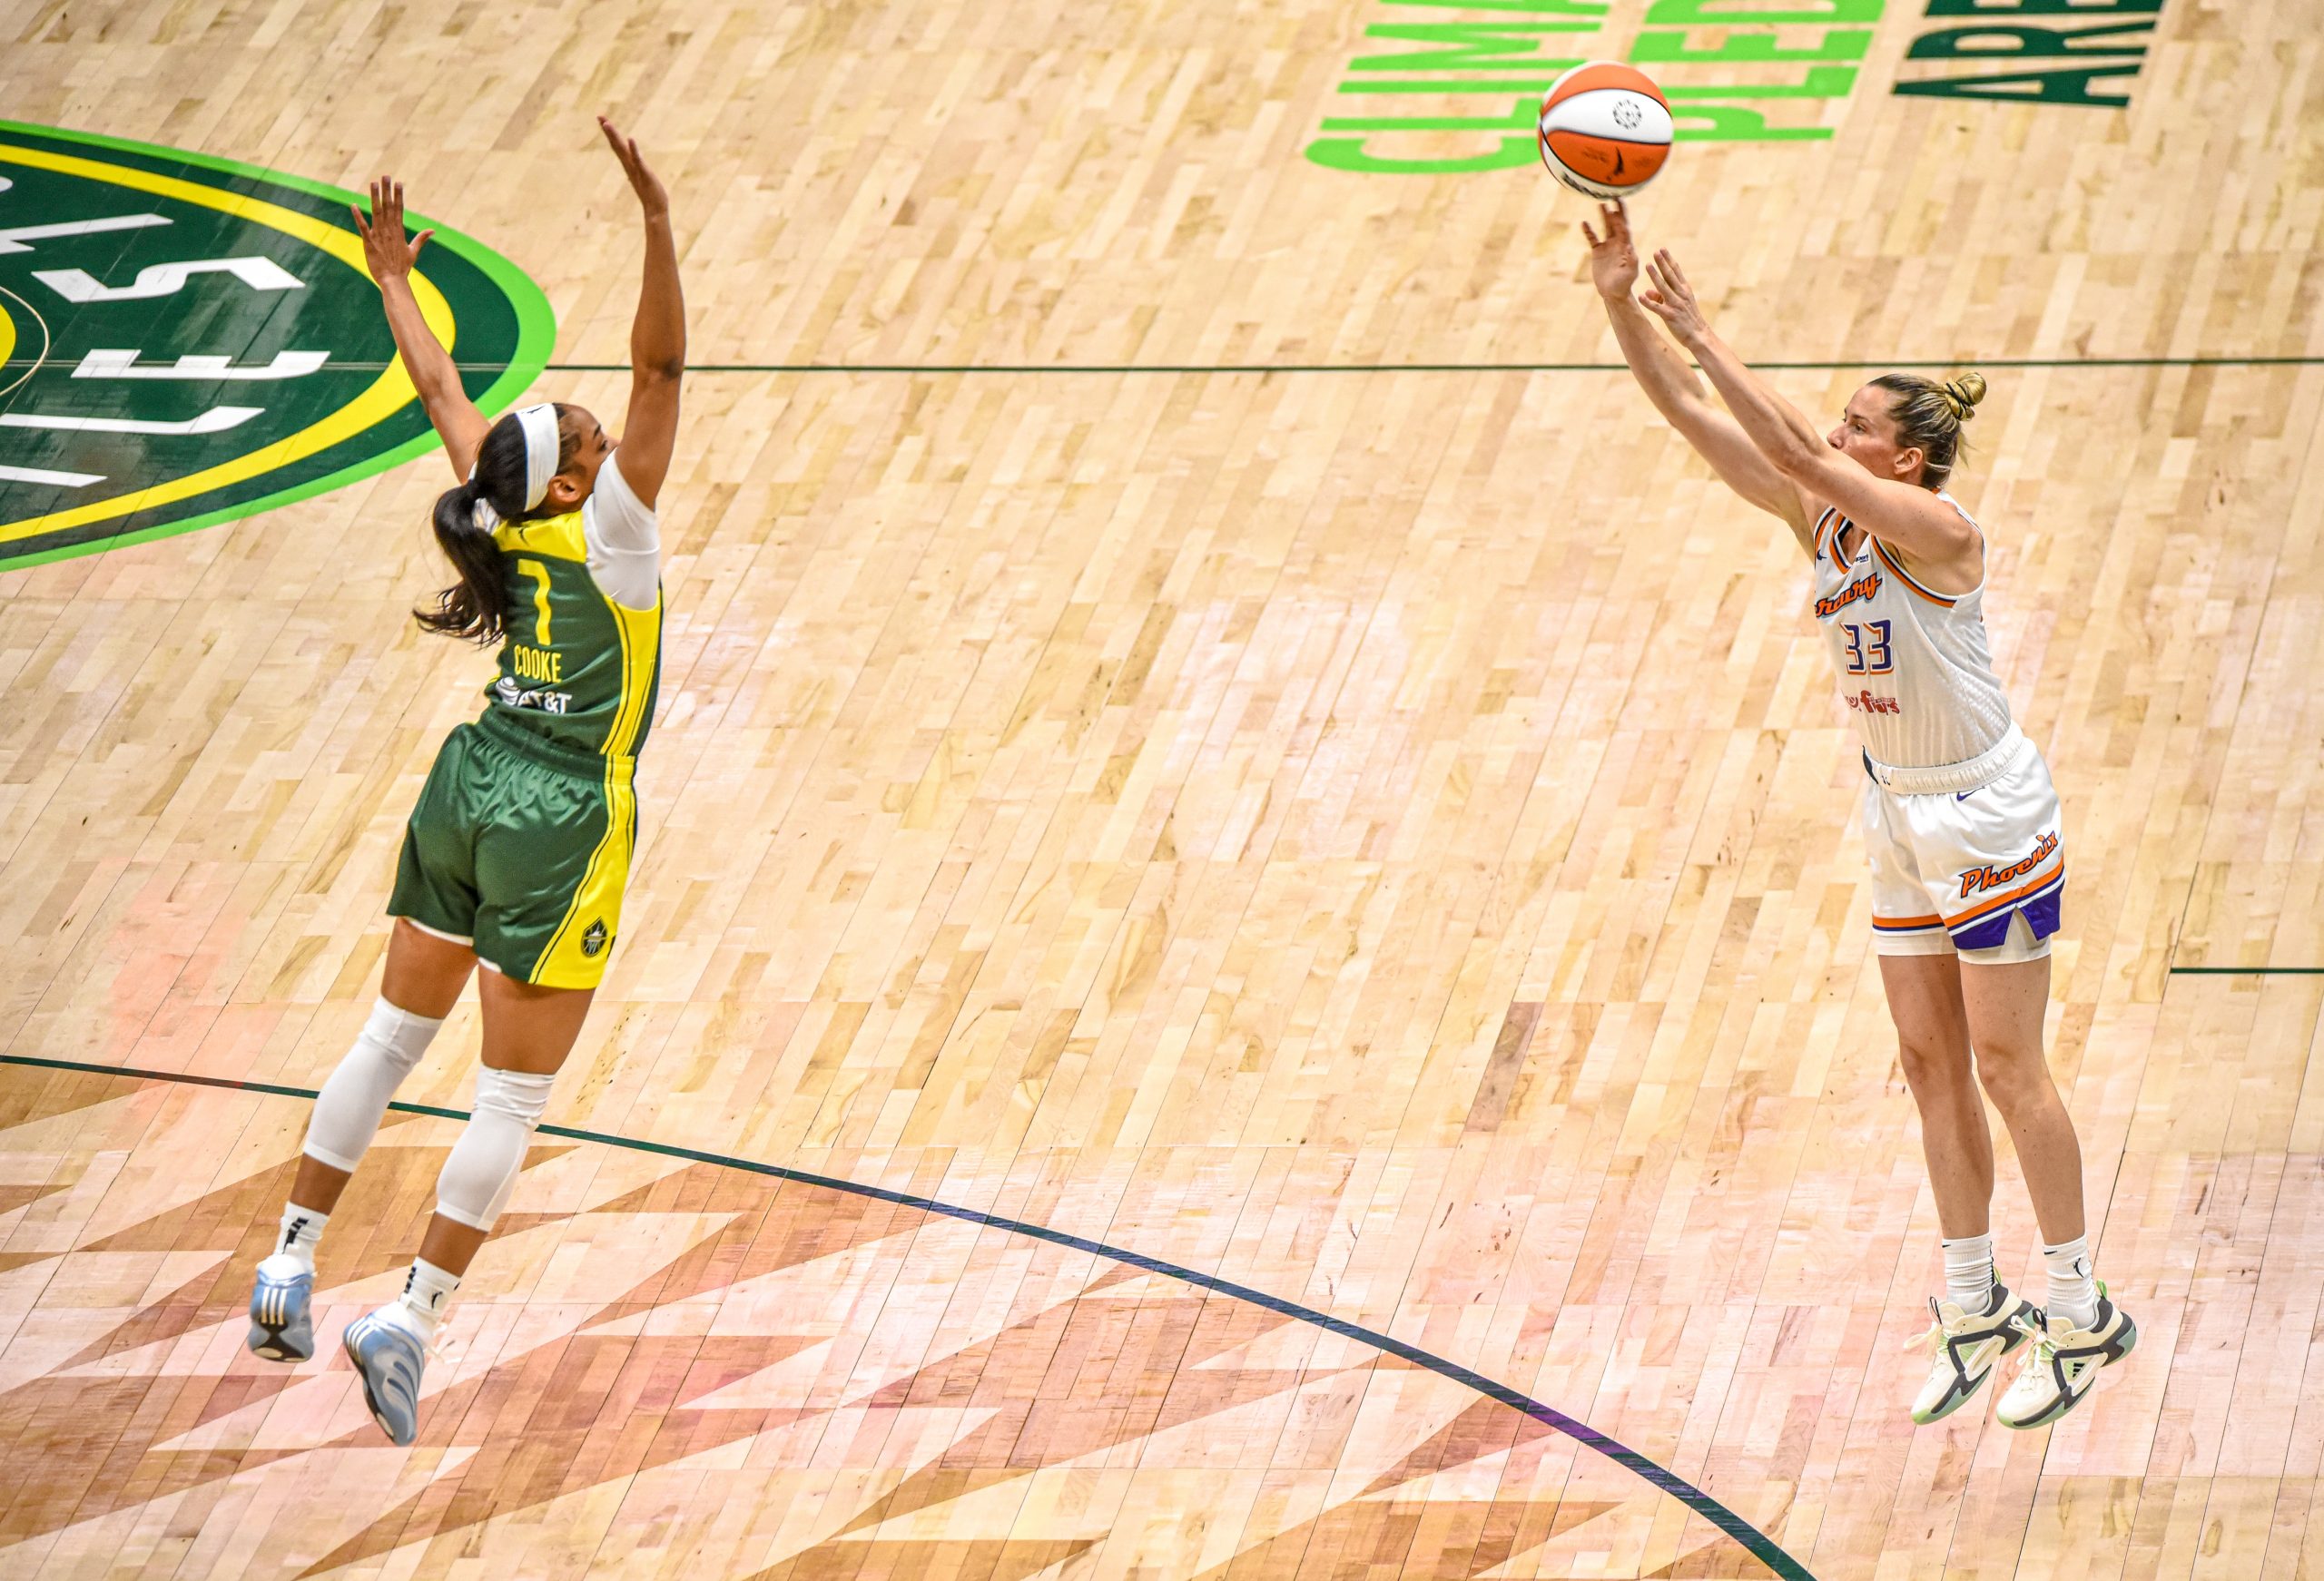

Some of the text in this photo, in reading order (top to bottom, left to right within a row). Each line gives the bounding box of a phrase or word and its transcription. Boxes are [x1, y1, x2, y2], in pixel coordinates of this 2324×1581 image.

[1815, 572, 1883, 618] rcury
[514, 644, 562, 682] COOKE
[1840, 620, 1894, 674] 33
[517, 690, 573, 714] AT&T
[1958, 830, 2058, 899] Phoenix
